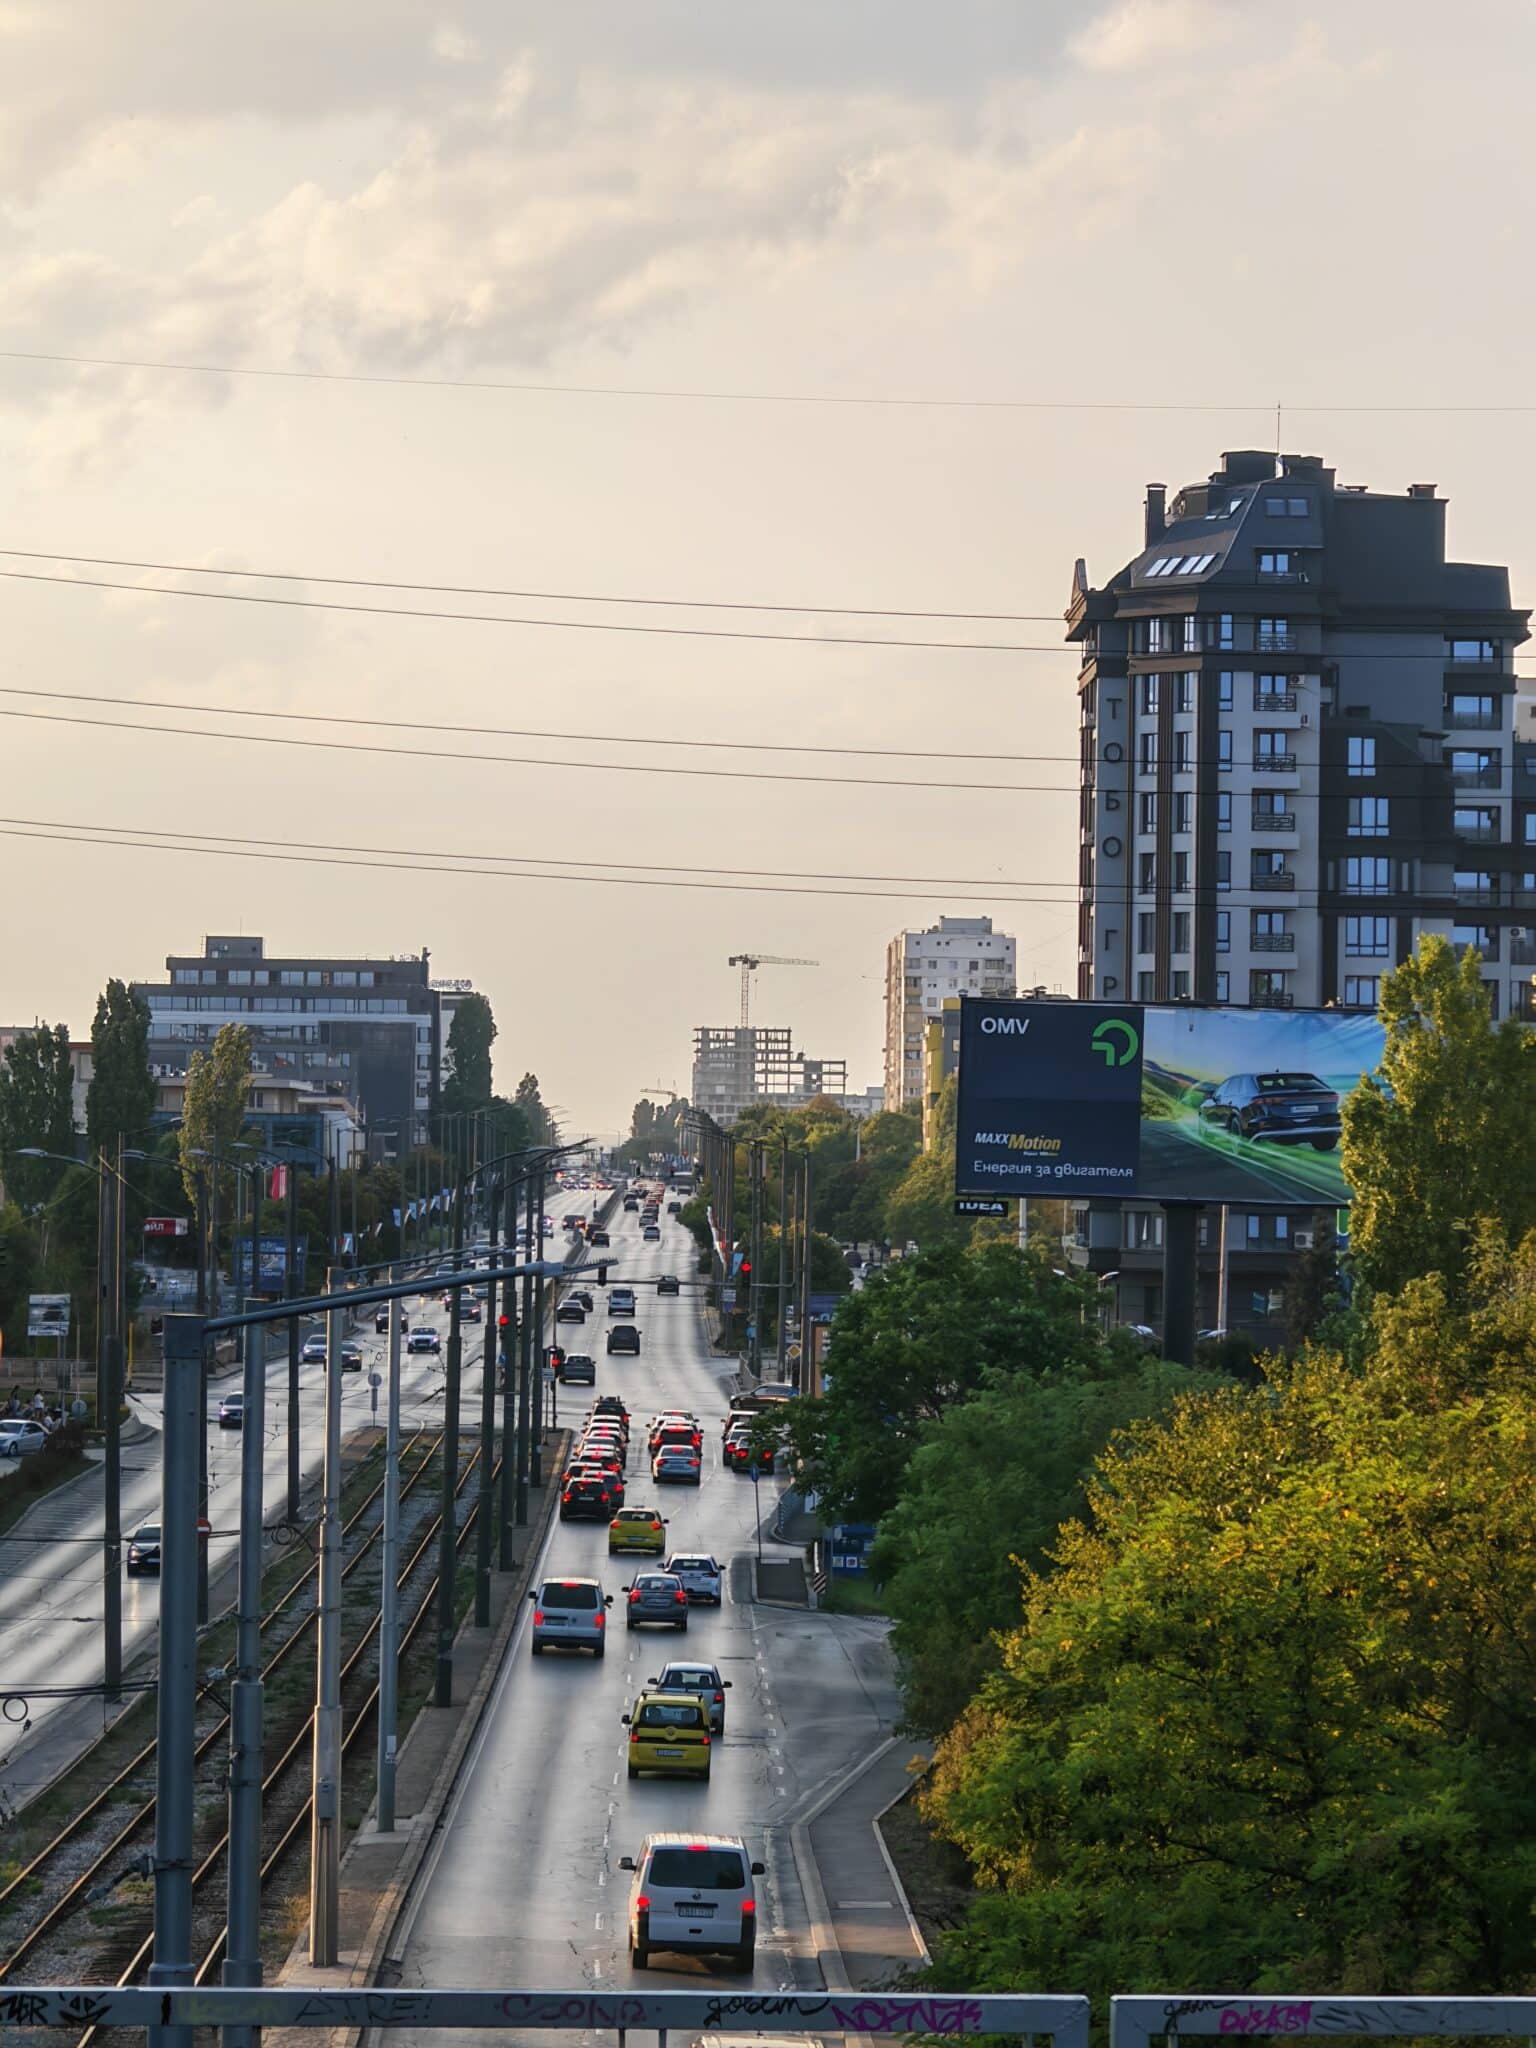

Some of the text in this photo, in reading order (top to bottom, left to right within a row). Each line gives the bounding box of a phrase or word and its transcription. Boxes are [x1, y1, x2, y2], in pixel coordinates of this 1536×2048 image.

[980, 1017, 1030, 1034] OMV
[973, 1160, 1134, 1178] Енергия за двигателя
[959, 1202, 1004, 1211] IDEA
